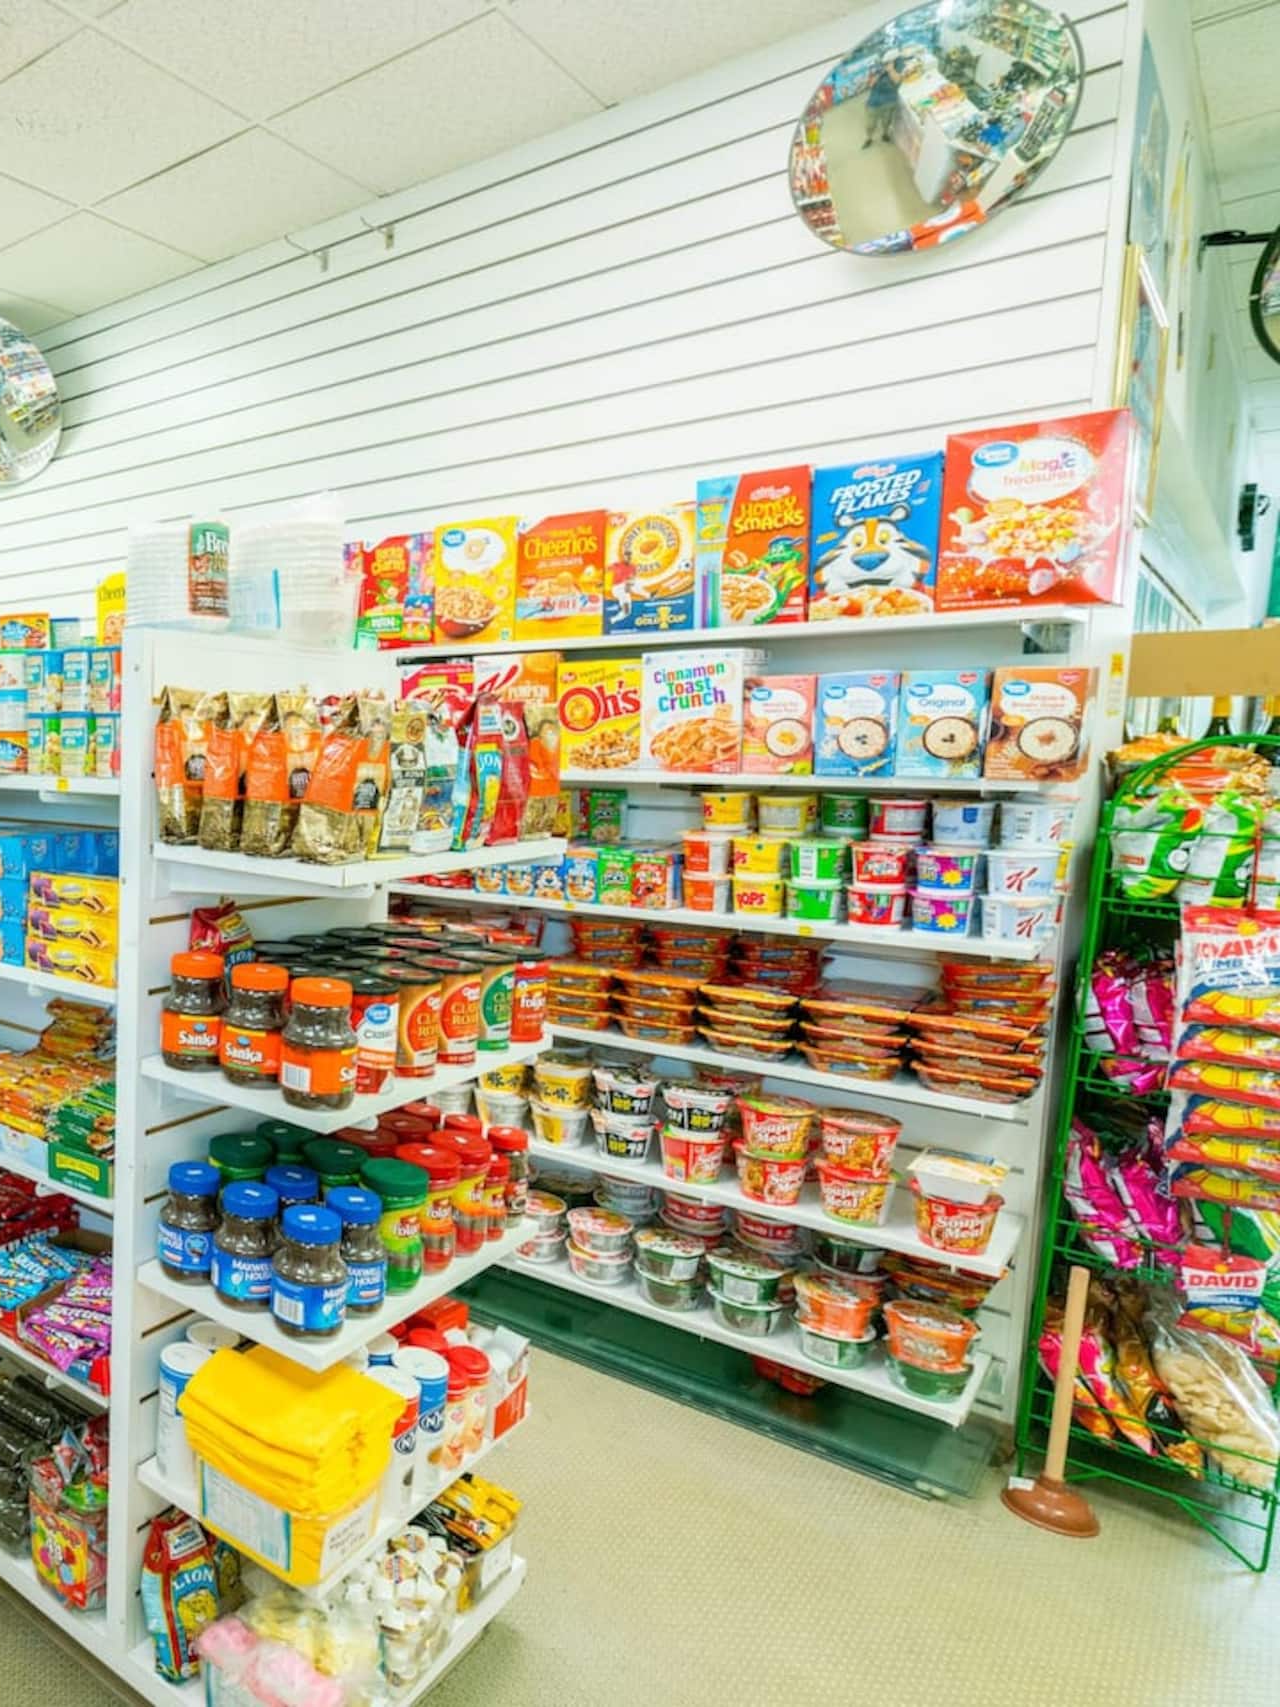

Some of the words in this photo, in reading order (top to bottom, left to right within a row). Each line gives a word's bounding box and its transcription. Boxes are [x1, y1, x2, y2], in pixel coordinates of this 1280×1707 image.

[830, 469, 922, 504] FROSTED
[835, 485, 913, 517] FLAKES
[523, 535, 598, 560] Cheerios
[653, 662, 726, 684] Cinnamon
[666, 677, 712, 695] Toast
[658, 687, 726, 712] Crunch
[1005, 867, 1039, 893] K
[1016, 912, 1044, 938] K
[178, 1030, 218, 1047] Sanka
[225, 1042, 263, 1063] Sanka
[1188, 1274, 1258, 1289] DAVID
[173, 1568, 213, 1590] LION
